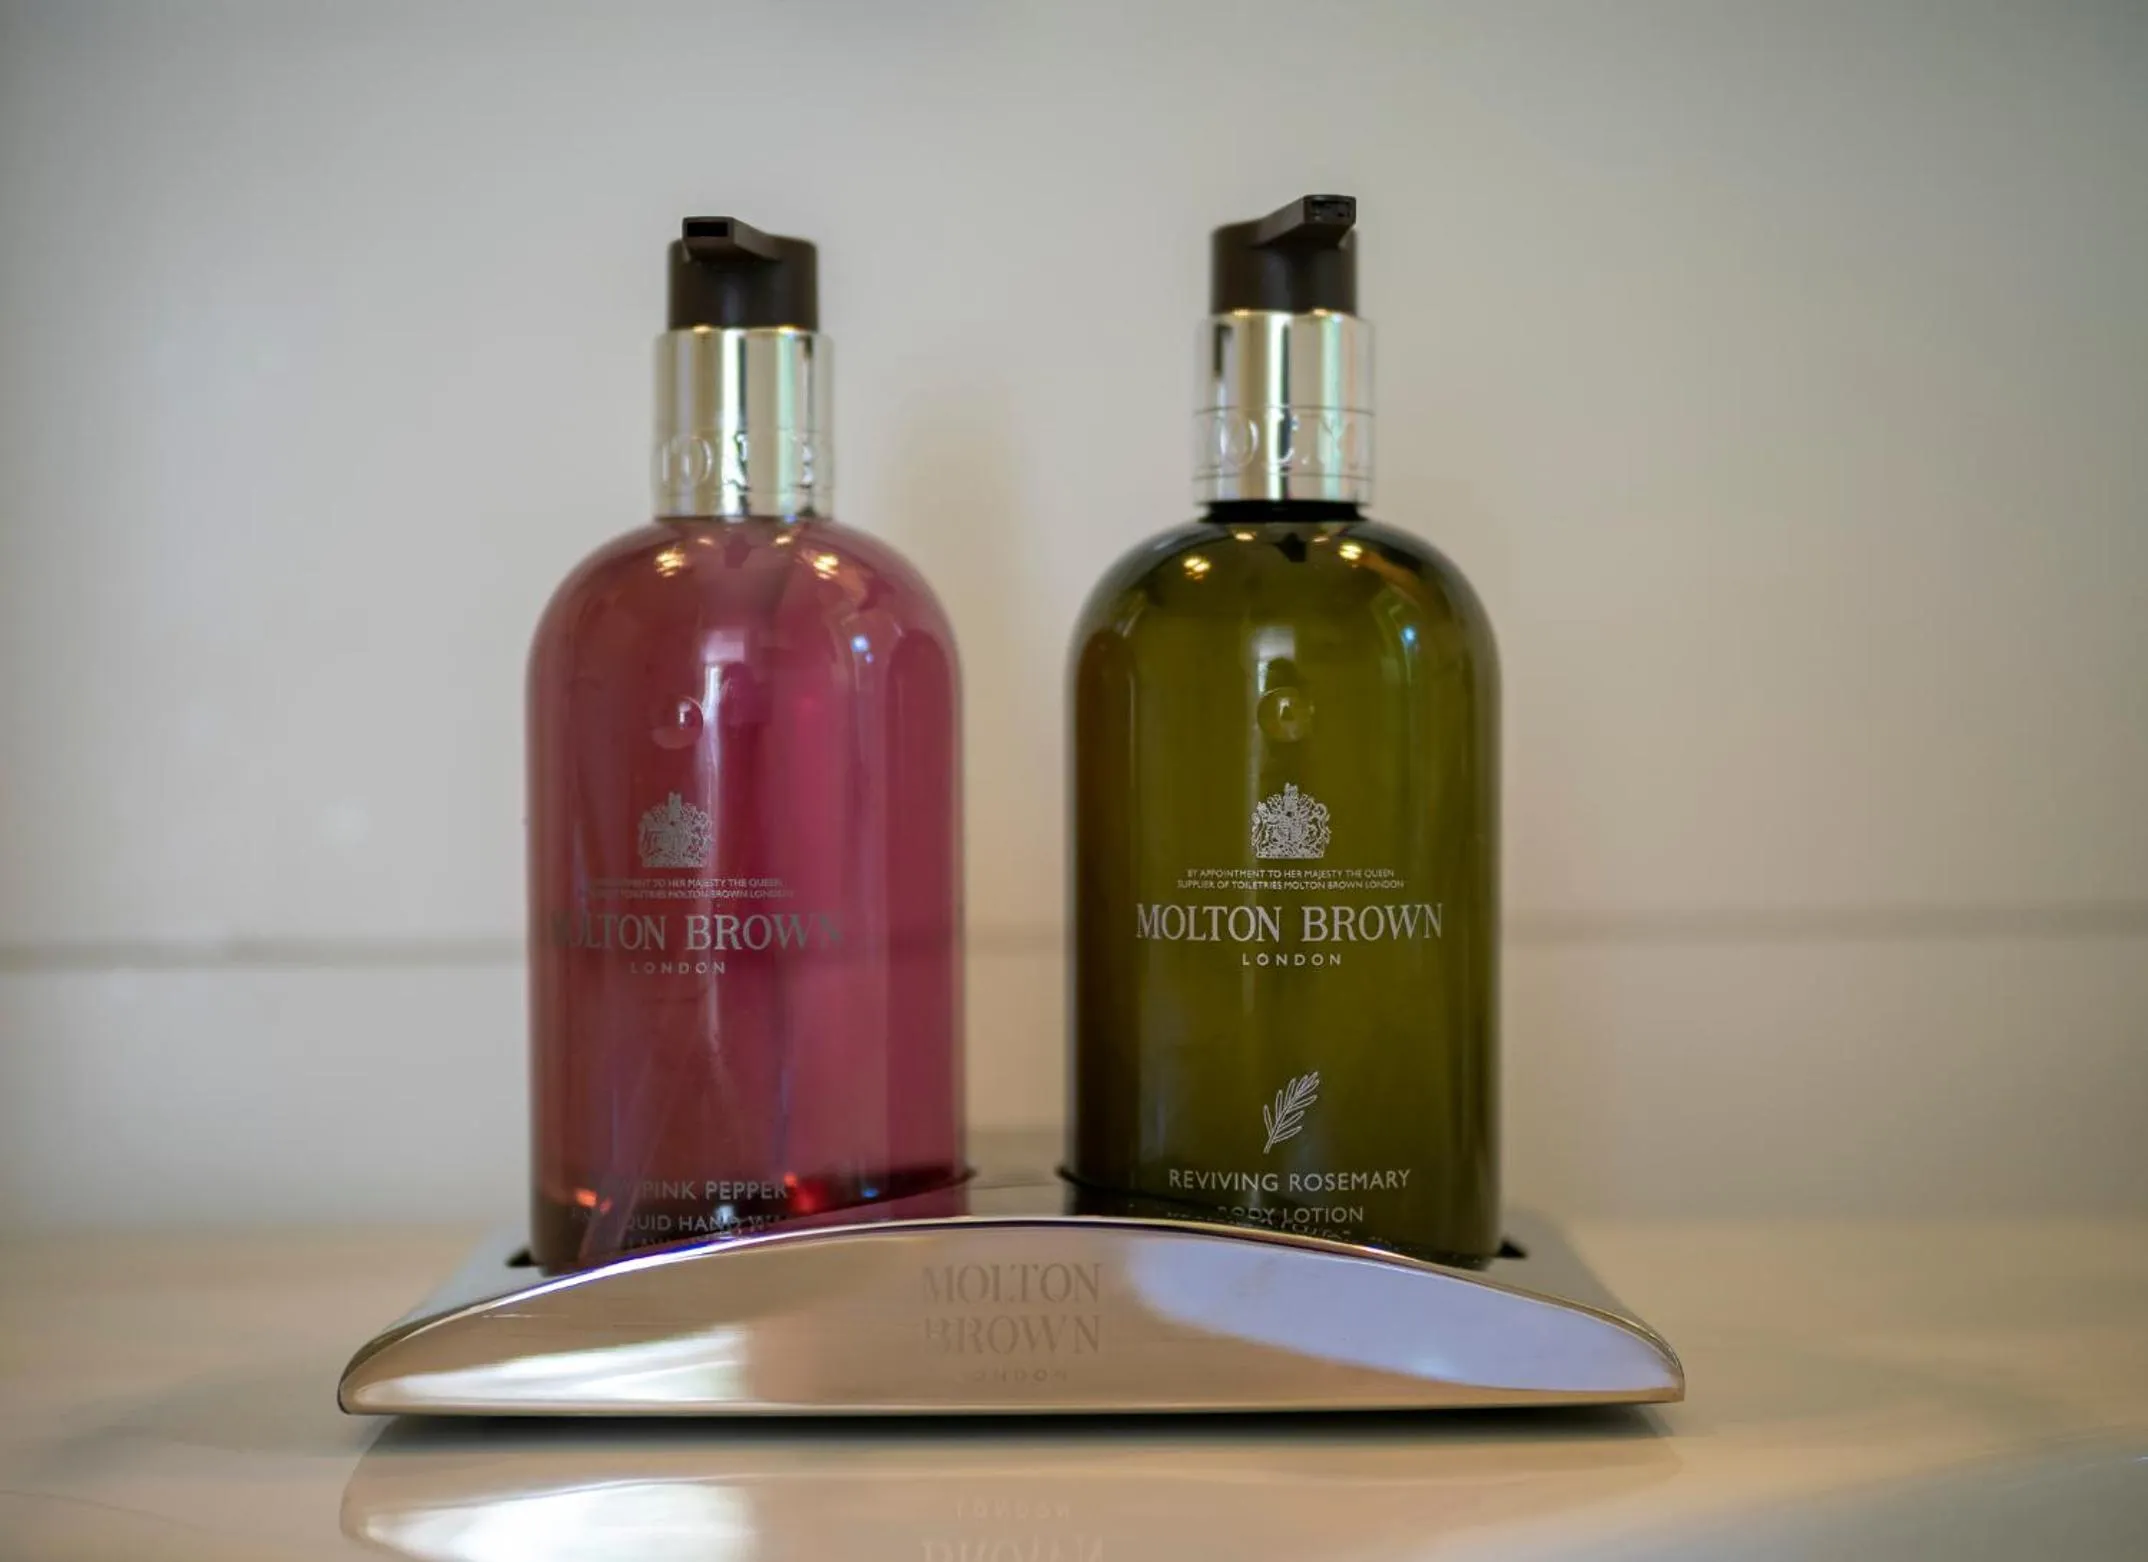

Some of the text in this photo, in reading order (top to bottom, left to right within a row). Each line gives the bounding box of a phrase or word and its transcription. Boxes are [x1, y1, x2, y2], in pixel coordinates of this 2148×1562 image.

[1267, 869, 1282, 878] TO
[1284, 869, 1302, 878] HER
[1304, 869, 1343, 880] MAJESTY
[1345, 869, 1361, 878] THE
[1284, 880, 1325, 890] MOLTON
[1328, 880, 1362, 890] BROWN
[1135, 903, 1444, 943] MOLTON BROWN
[630, 961, 726, 975] LONDON
[1242, 953, 1342, 967] LONDON
[1168, 1168, 1412, 1192] REVIVING ROSEMARY
[642, 1180, 697, 1201] PINK
[704, 1180, 788, 1201] PEPPER
[1282, 1205, 1364, 1224] LOTION
[922, 1262, 1103, 1304] MOLTON
[923, 1314, 1102, 1354] BROWN
